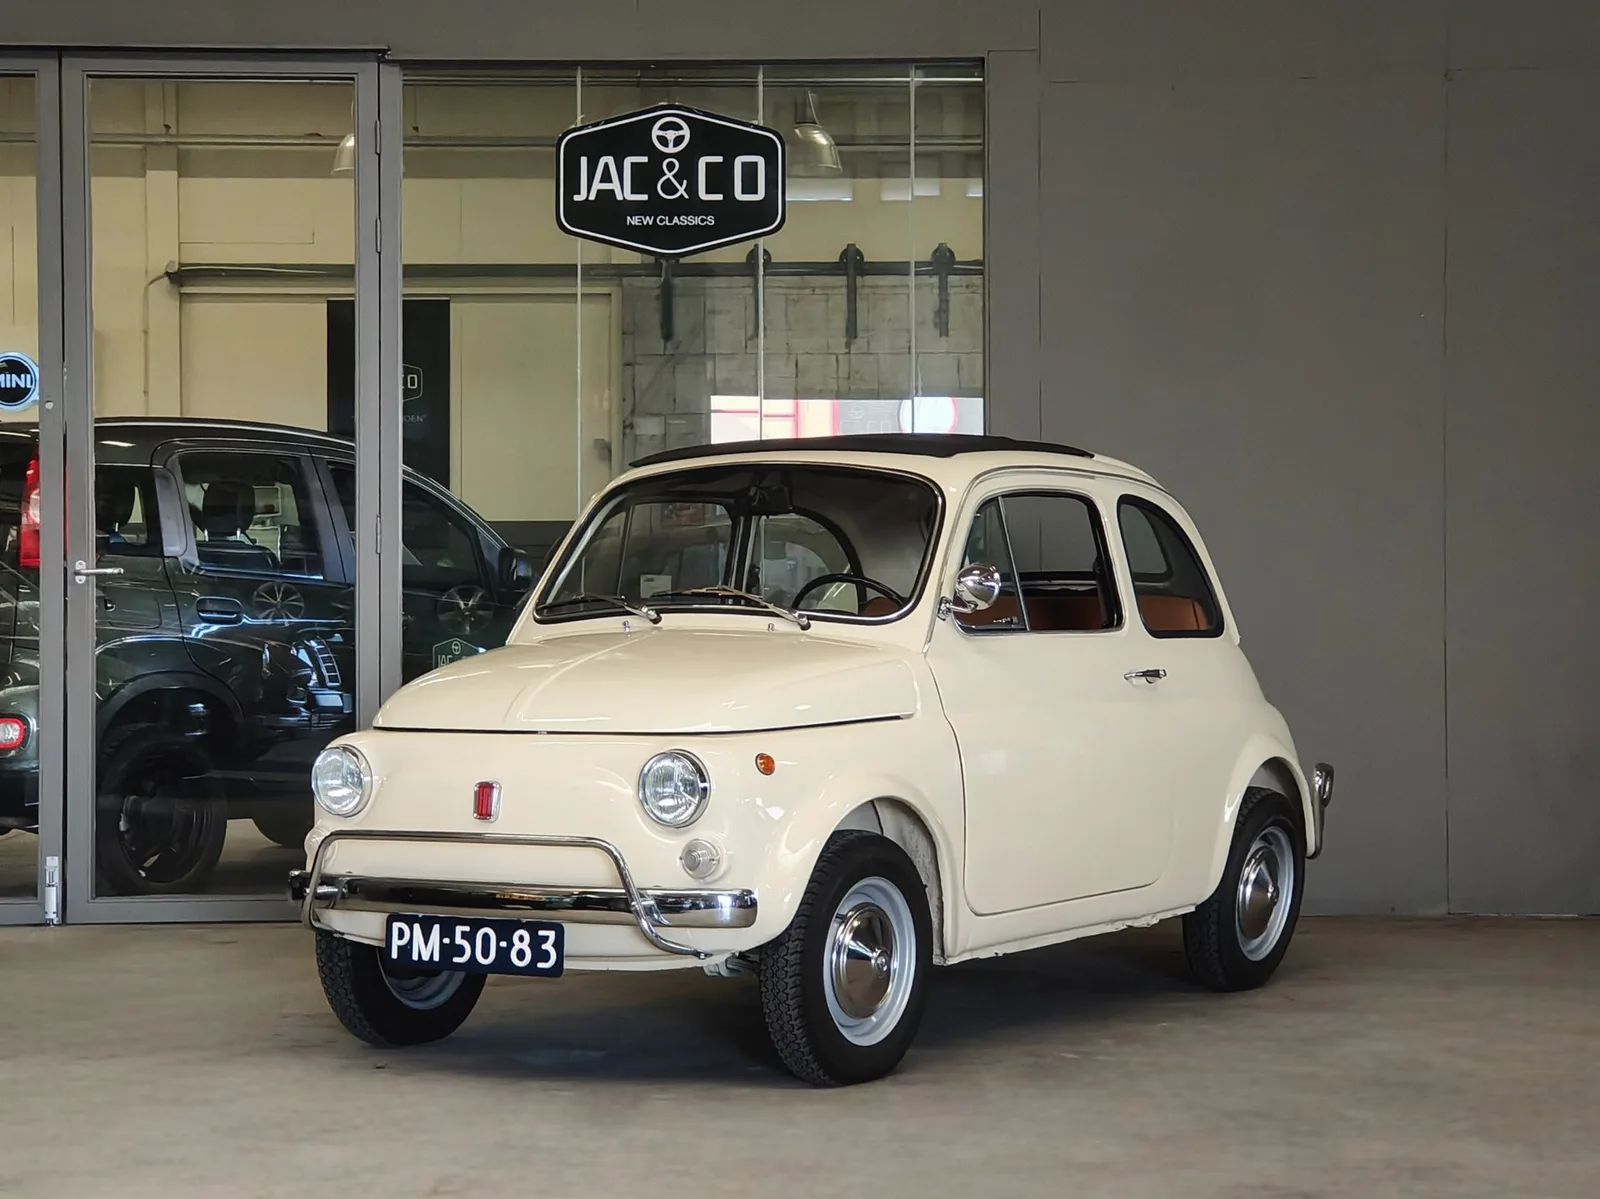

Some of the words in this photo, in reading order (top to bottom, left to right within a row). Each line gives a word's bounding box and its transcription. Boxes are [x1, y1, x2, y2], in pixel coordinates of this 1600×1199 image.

[573, 156, 648, 201] JAC
[698, 156, 765, 201] CO
[626, 215, 654, 226] NEW
[657, 215, 715, 226] CLASSICS
[391, 921, 557, 969] PM-50-83
